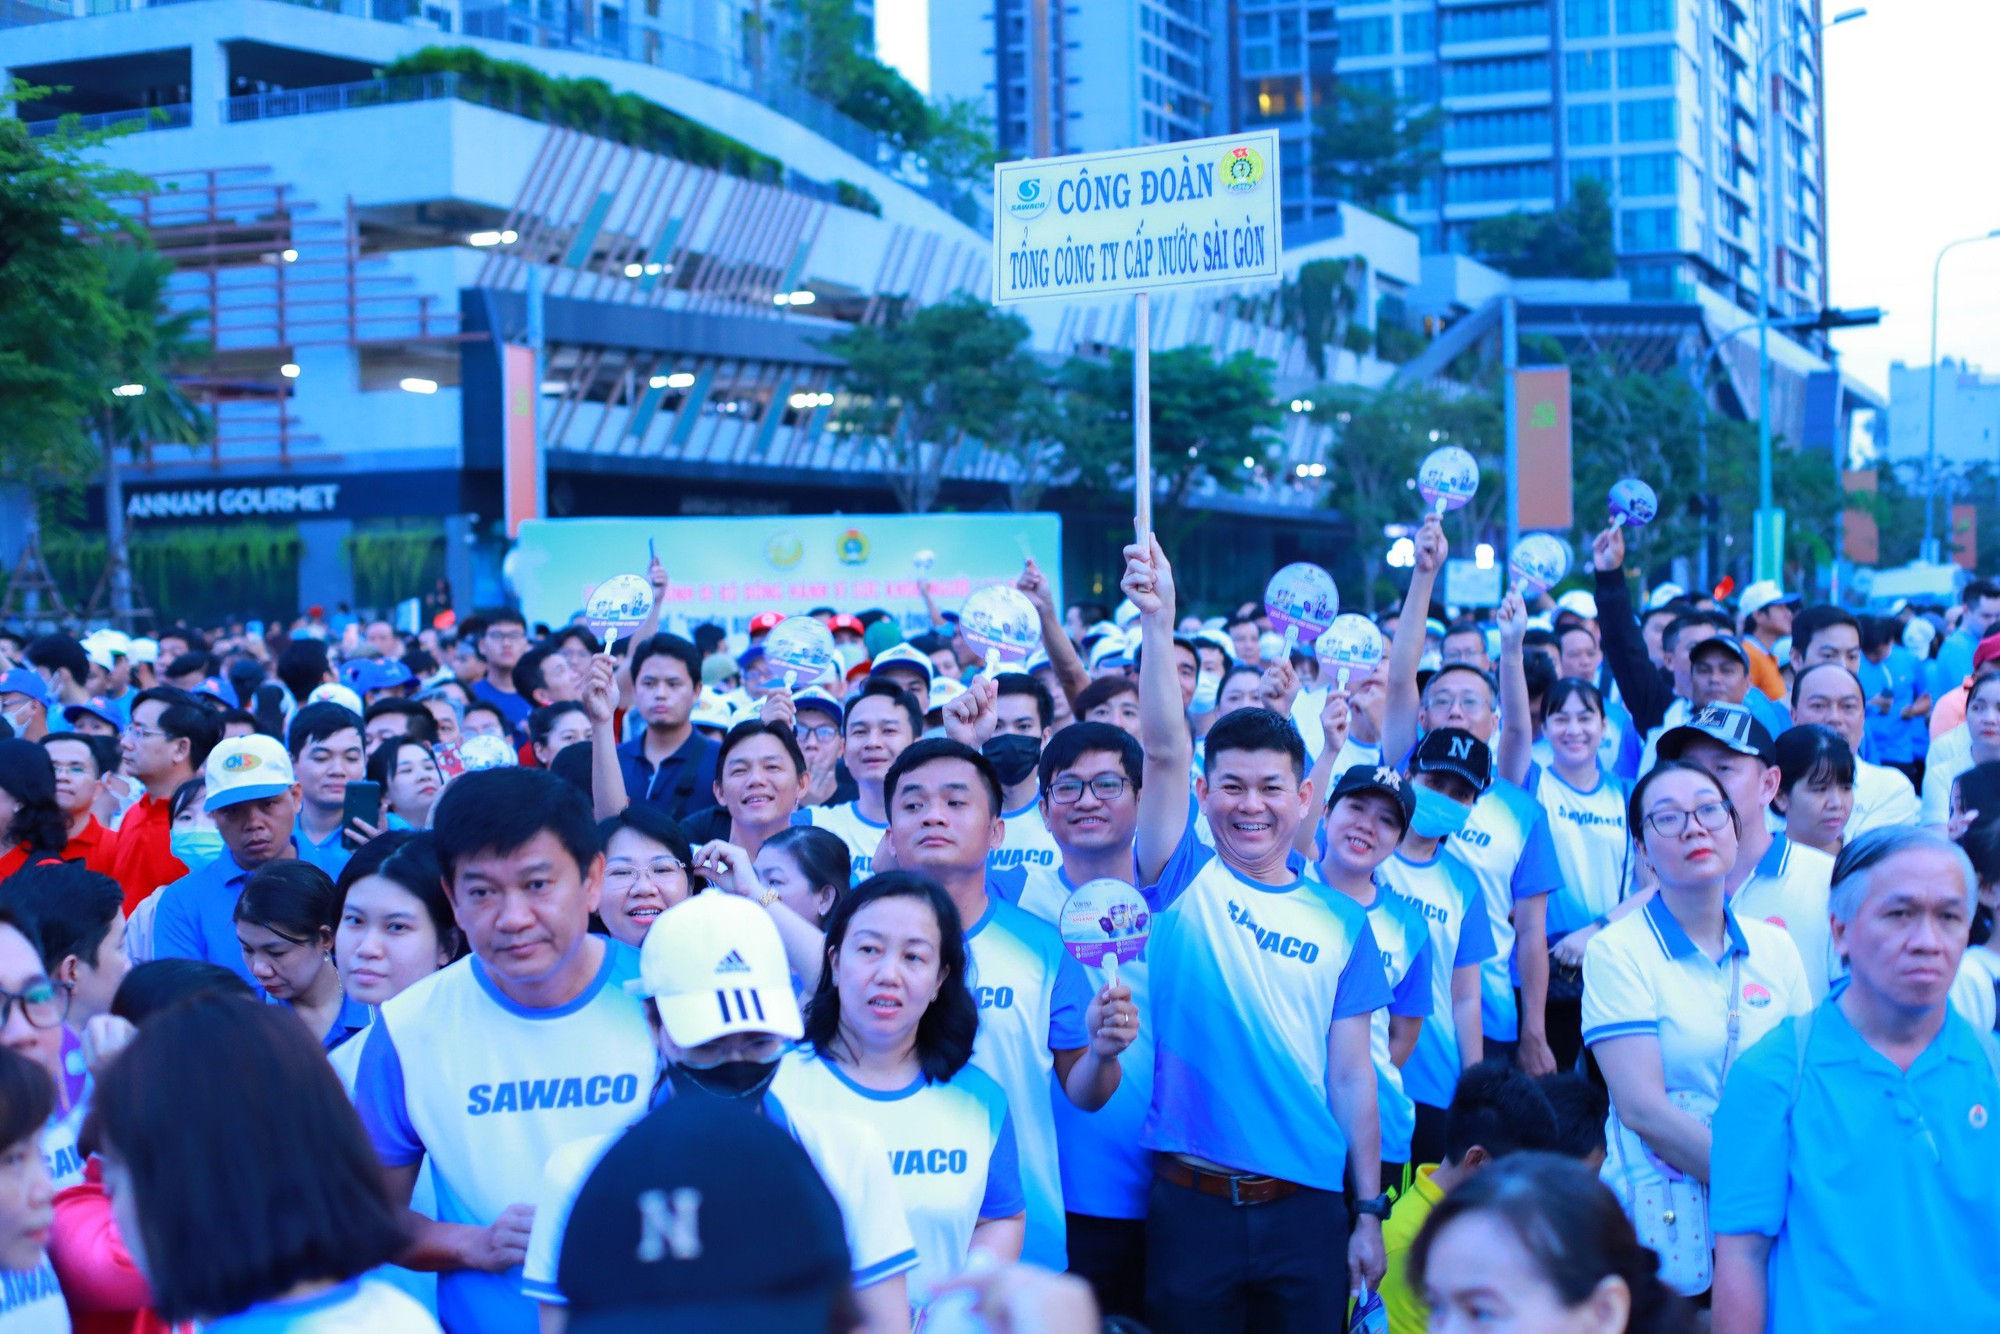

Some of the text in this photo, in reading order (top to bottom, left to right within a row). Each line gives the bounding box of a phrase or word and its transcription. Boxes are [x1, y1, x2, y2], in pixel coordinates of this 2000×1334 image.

[1058, 155, 1214, 215] CÔNG ĐOÀN
[1011, 202, 1046, 211] SAWACO
[1010, 215, 1265, 290] TỔNG CÔNG TY CẤP NƯỚC SÀI GÒN
[127, 484, 340, 517] ANNAM GOURMET
[1448, 735, 1474, 760] N
[988, 849, 1054, 867] WACO
[467, 1073, 638, 1116] SAWACO
[636, 1187, 702, 1262] N
